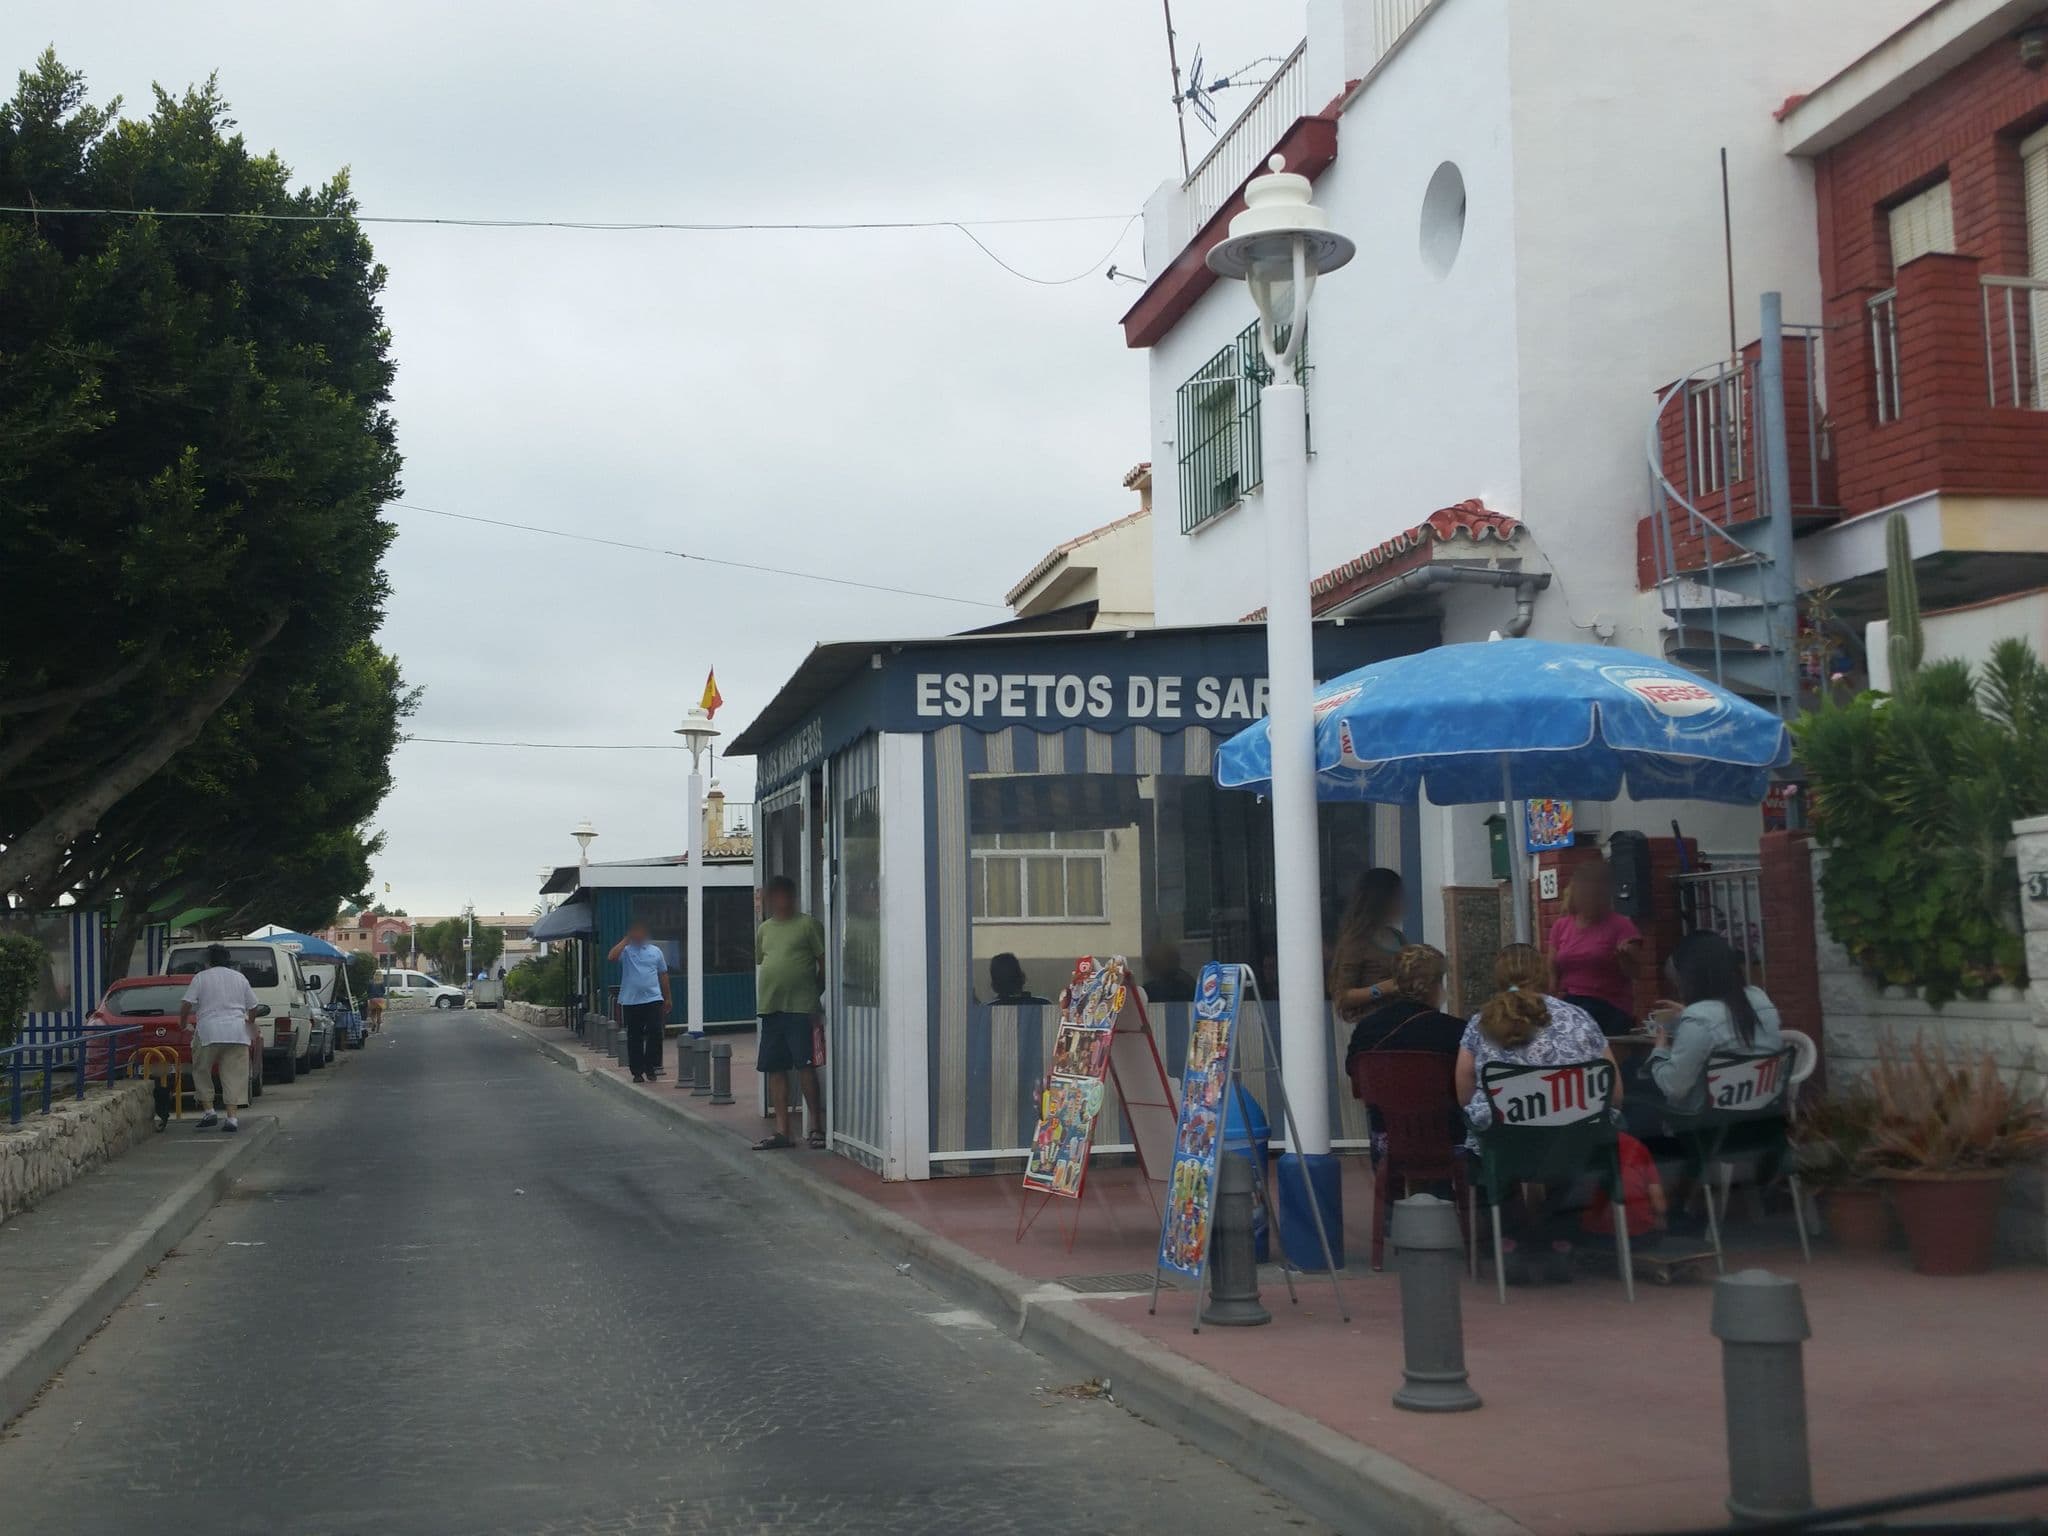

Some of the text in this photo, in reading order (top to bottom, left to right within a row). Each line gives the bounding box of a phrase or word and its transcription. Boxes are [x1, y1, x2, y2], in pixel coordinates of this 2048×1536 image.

[916, 673, 1112, 718] ESPETOS
[1128, 676, 1182, 718] DE
[1543, 873, 1555, 895] 35
